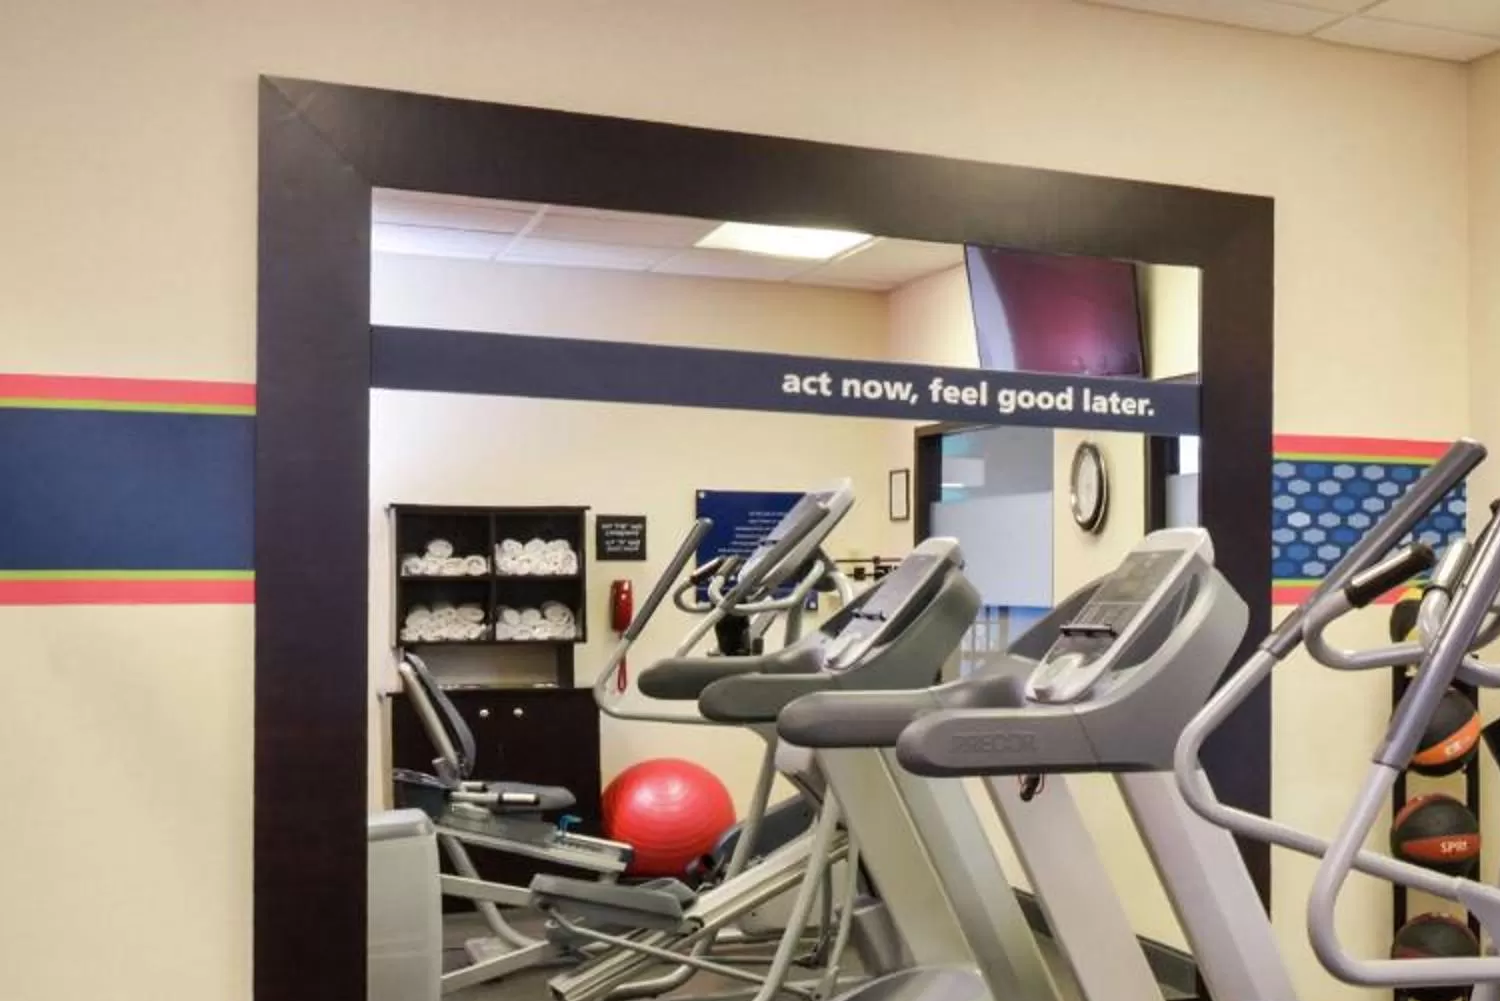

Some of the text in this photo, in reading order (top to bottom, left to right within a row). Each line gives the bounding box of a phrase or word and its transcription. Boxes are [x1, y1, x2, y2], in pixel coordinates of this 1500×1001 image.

[782, 372, 1155, 417] act now, feel good later.
